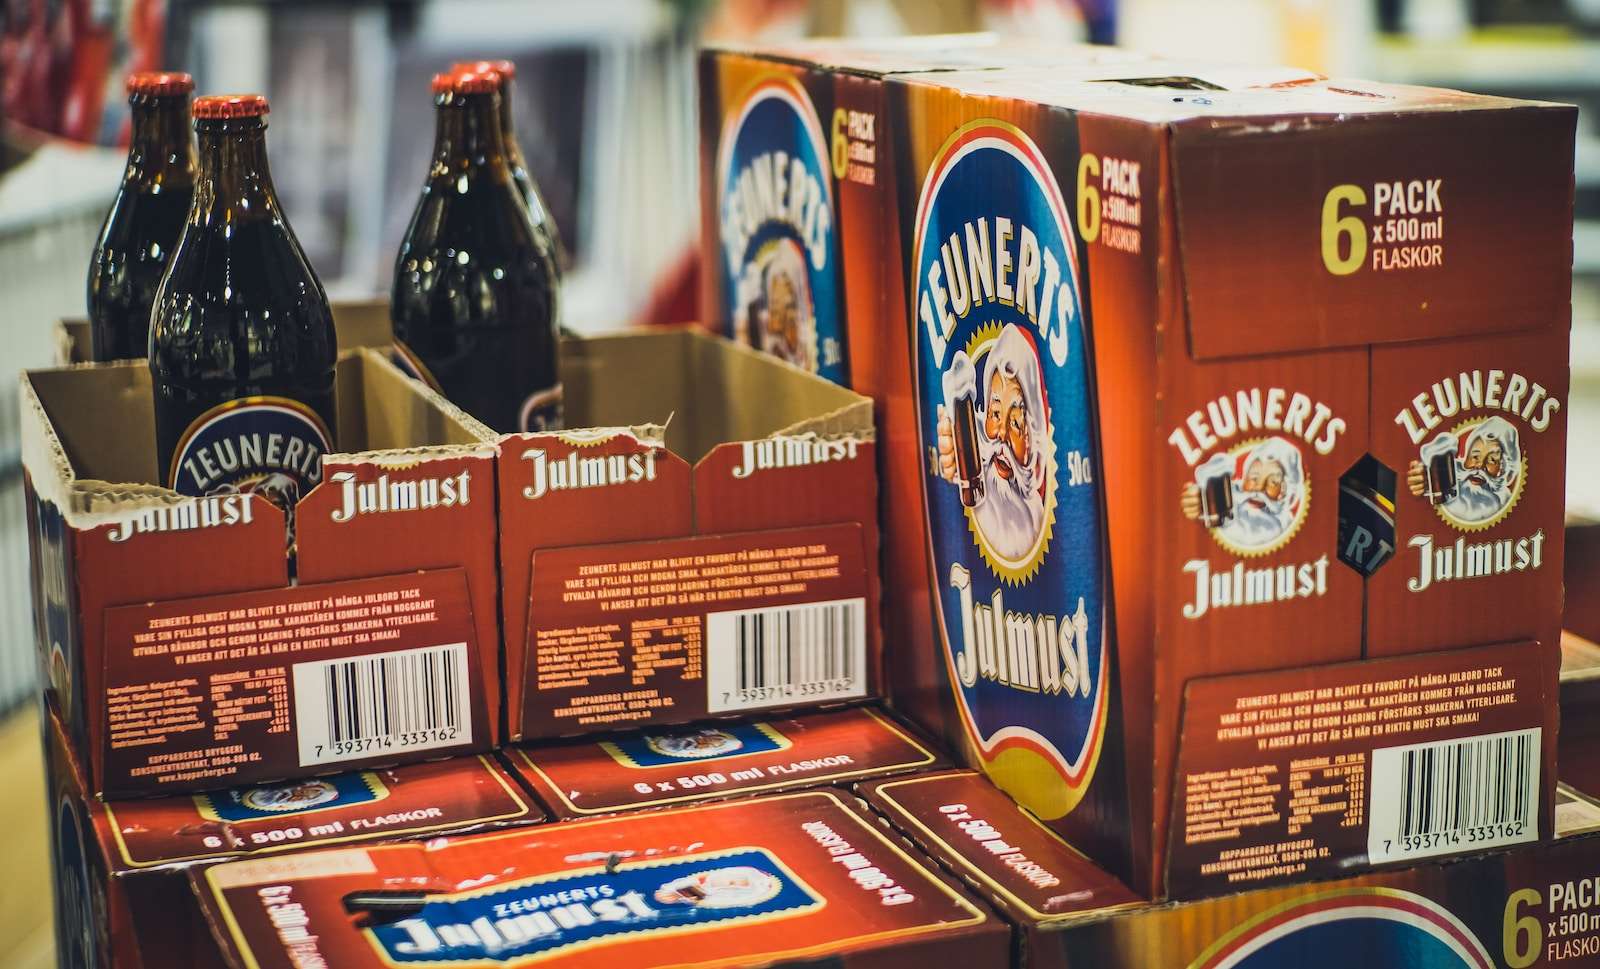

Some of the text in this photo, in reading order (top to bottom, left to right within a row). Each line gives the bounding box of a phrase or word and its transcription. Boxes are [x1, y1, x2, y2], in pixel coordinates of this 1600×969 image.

[832, 108, 848, 178] 6
[1077, 153, 1140, 242] 6 PACK
[1102, 222, 1140, 254] FLASKOR
[1322, 179, 1442, 275] 6 PACK
[1373, 245, 1442, 270] FLASKOR
[920, 217, 1074, 369] ZEUNERTS
[1168, 387, 1346, 466] ZEUNERTS
[1394, 369, 1560, 444] ZEUNERTS
[184, 432, 323, 490] ZEUNERTS
[521, 447, 657, 500] Julmust
[330, 470, 471, 523] Julmust
[1407, 528, 1545, 592] Julmust
[1182, 554, 1329, 619] Julmust
[134, 600, 435, 643] VARE SIN FYLLIGA OCH MOGNA SMAK. KARAKTÄREN KOMMER FRÅN NOGGRANT
[149, 589, 420, 629] ZEUNERTS JULMUST HAR BLIVIT EN FAVORIT PÅ MÅNGA JULBORD TACK
[950, 562, 1091, 698] Julmust
[133, 612, 438, 656] UTVALDA RÅVAROR OCH GENOM LAGRING FÖRSTÄRKS SMAKERNA YTTERLIGARE.
[175, 630, 400, 665] VI ANSER ATT DET ÄR SÅ HÄR EN RIKTIG MUST SKA SMAKA!
[722, 679, 851, 704] 7 393714 333162
[1220, 680, 1515, 724] VARE SIN FYLLIGA OCH MOGNA SMAK. KARAKTÄREN KOMMER FRÅN NOGGRANT
[1236, 667, 1502, 709] ZEUNERTS JULMUST HAR BLIVIT EN FAVORIT PÅ MÅNGA JULBORD TACK
[1217, 693, 1517, 740] UTVALDA RÅVAROR OCH GENOM LAGRING FÖRSTÄRKS SMAKERNA YTTERLIGARE.
[1258, 712, 1479, 750] VI ANSER ATT DET ÄR SÅ HÄR EN RIKTIG MUST SKA SMAKA!
[315, 728, 456, 757] 7 393714 333162
[634, 755, 854, 794] 6 x 500 ml FLASKOR
[203, 808, 442, 848] 6 x 500 ml FLASKOR
[1384, 822, 1523, 854] 7 393714 333162
[1000, 853, 1060, 888] FLASKOR
[1220, 844, 1274, 860] KOPPARBERGS
[1229, 863, 1306, 882] www.kopparbergs.se
[394, 890, 661, 954] Julmust
[493, 885, 614, 917] ZEUNERTS
[1503, 888, 1542, 968] 6
[1548, 936, 1600, 962] FLASKO
